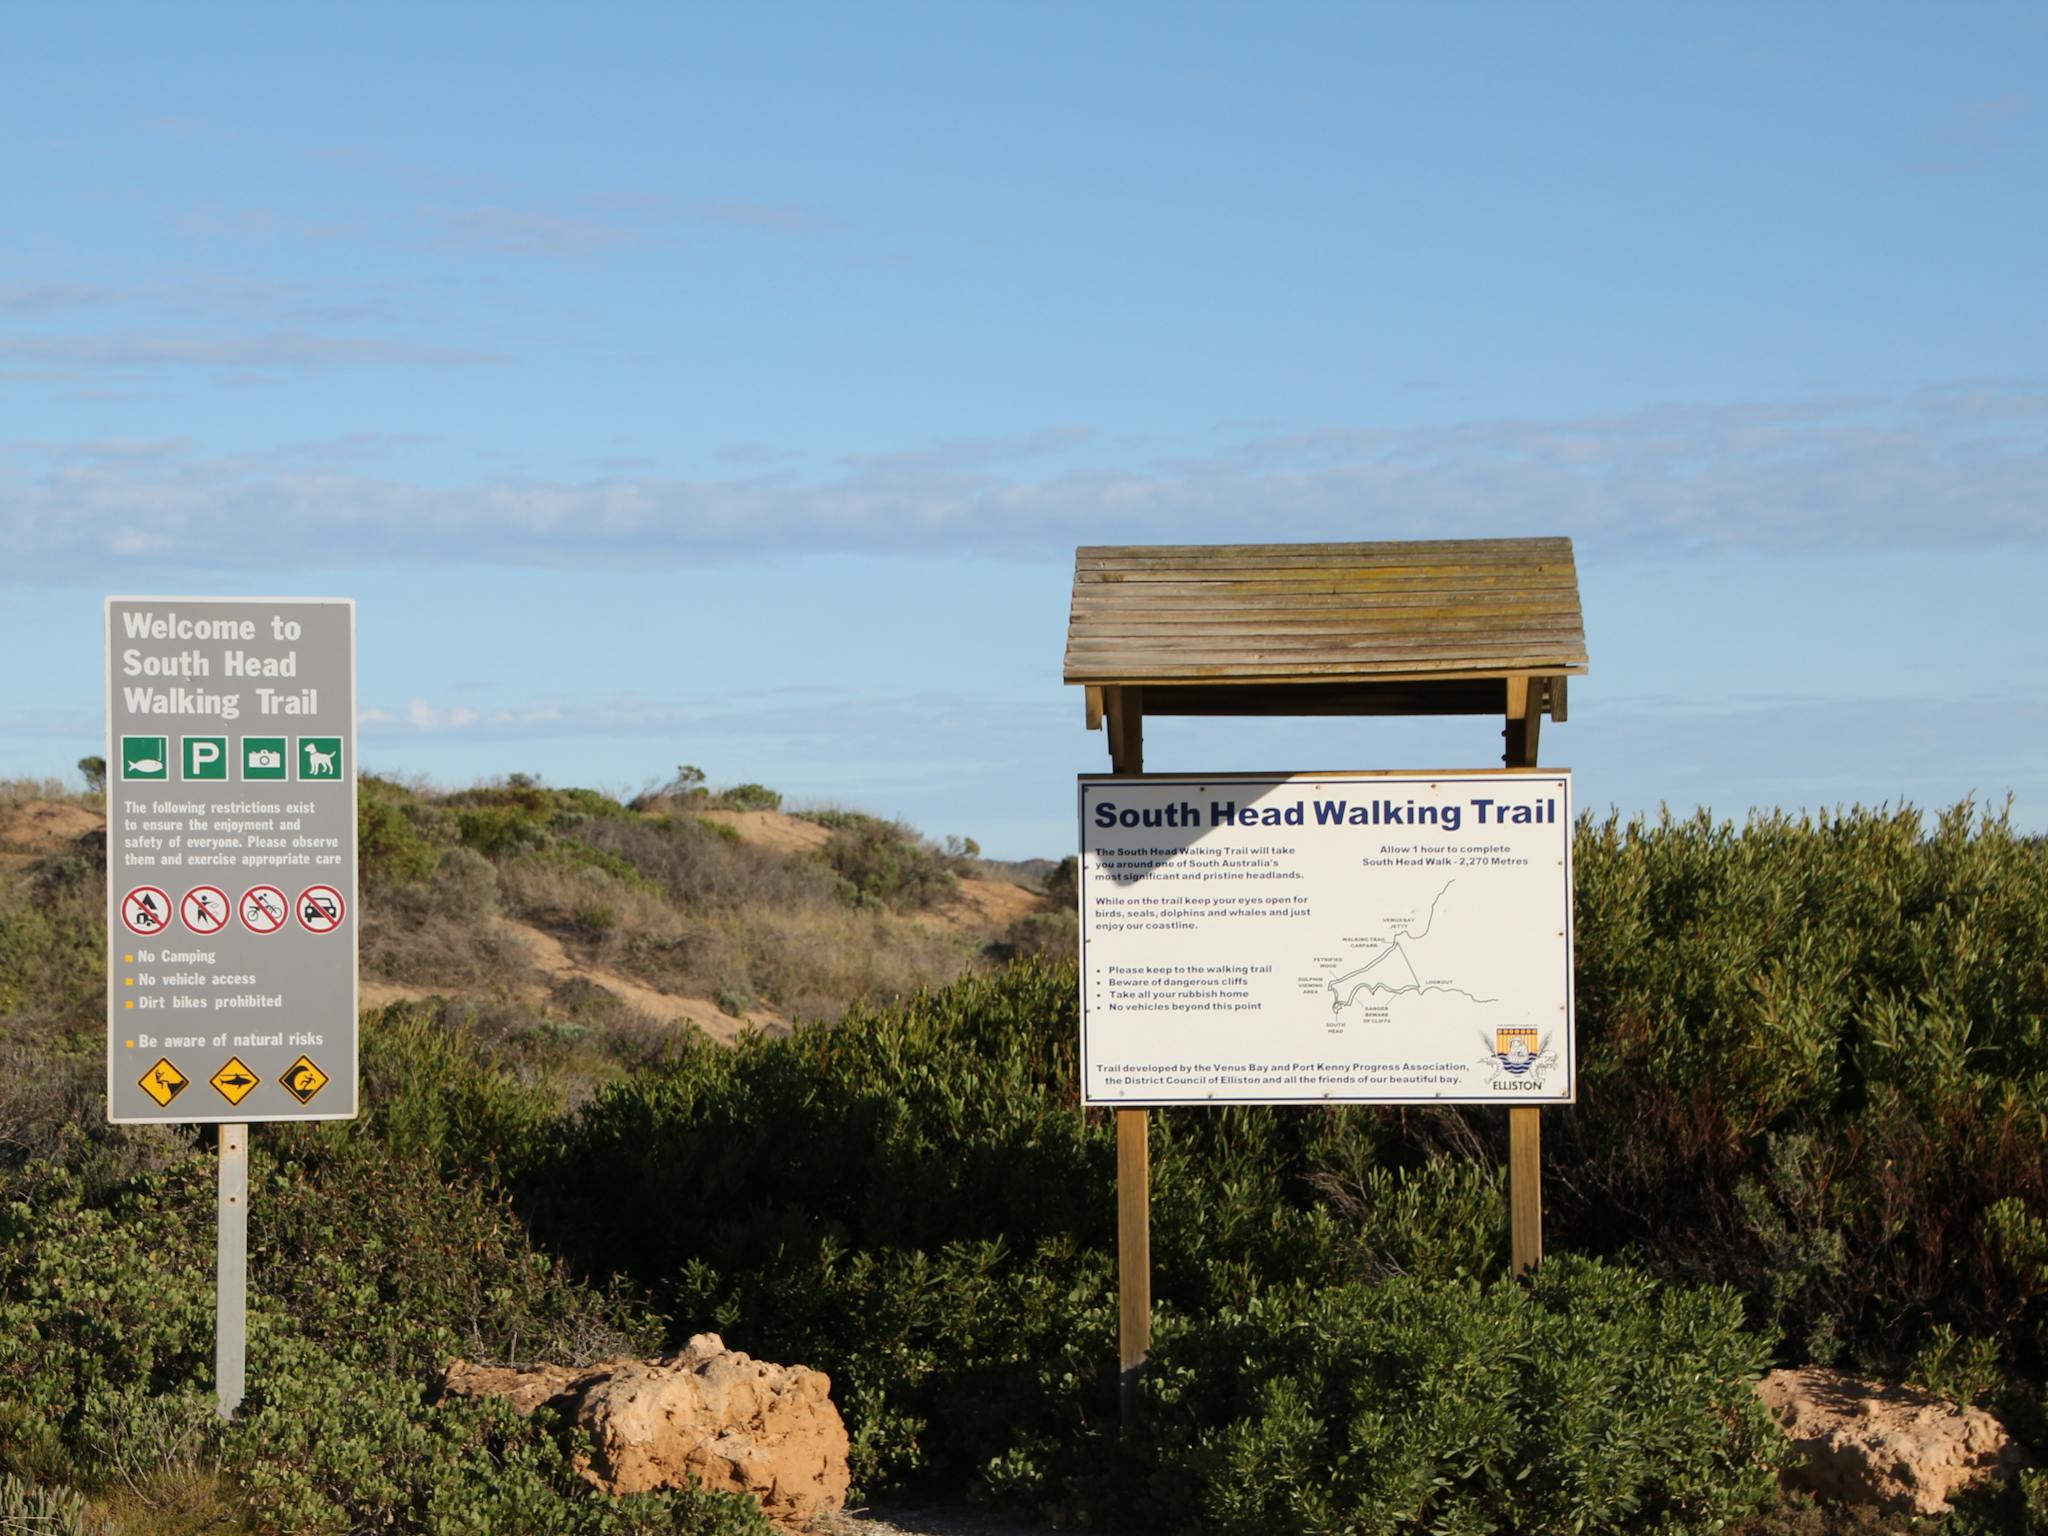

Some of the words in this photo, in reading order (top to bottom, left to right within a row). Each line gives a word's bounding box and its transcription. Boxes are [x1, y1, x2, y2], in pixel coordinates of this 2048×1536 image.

[122, 612, 256, 640] Welcome
[271, 615, 301, 640] to
[123, 649, 209, 676] South
[224, 651, 297, 677] Head
[123, 687, 240, 719] Walking
[255, 688, 318, 714] Trail
[193, 742, 219, 774] P
[124, 801, 147, 814] The
[152, 801, 206, 816] following
[211, 801, 280, 814] restrictions
[286, 801, 315, 814] exist
[1095, 802, 1200, 828] South
[1210, 801, 1305, 827] Head
[1313, 800, 1461, 831] Walking
[1470, 799, 1555, 824] Trail
[124, 819, 137, 831] to
[143, 821, 183, 831] ensure
[188, 819, 208, 831] the
[213, 819, 274, 833] enjoyment
[280, 818, 301, 831] and
[124, 835, 163, 850] safety
[168, 835, 181, 848] of
[187, 838, 243, 850] everyone.
[247, 835, 287, 848] Please
[292, 835, 338, 848] observe
[1095, 848, 1114, 856] The
[1117, 848, 1147, 856] South
[1150, 848, 1177, 856] Head
[1179, 848, 1221, 856] Walking
[1380, 846, 1410, 854] Allow
[1460, 845, 1511, 854] complete
[125, 852, 155, 865] them
[161, 852, 182, 865] and
[188, 852, 236, 865] exercise
[242, 852, 311, 867] appropriate
[316, 855, 342, 865] care
[1116, 860, 1153, 868] around
[1222, 859, 1279, 867] Australia's
[1362, 858, 1394, 866] South
[1396, 858, 1423, 866] Head
[1459, 857, 1489, 867] 2,270
[1491, 857, 1528, 865] Metres
[1123, 872, 1180, 881] significant
[1182, 872, 1201, 880] and
[1203, 872, 1244, 881] pristine
[1246, 871, 1305, 879] headlands.
[1142, 897, 1159, 905] the
[1161, 897, 1183, 905] trail
[1185, 897, 1211, 906] keep
[1213, 898, 1236, 906] your
[1096, 910, 1125, 918] birds,
[1127, 910, 1159, 918] seals,
[1160, 909, 1205, 918] dolphins
[1207, 909, 1227, 917] and
[1290, 908, 1311, 918] just
[1096, 923, 1124, 932] enjoy
[1146, 921, 1199, 930] coastline.
[138, 950, 155, 963] No
[161, 950, 216, 964] Camping
[1108, 966, 1144, 974] Please
[1146, 966, 1173, 975] keep
[1174, 966, 1185, 974] to
[1187, 966, 1204, 974] the
[1206, 965, 1248, 975] walking
[1250, 965, 1272, 973] trail
[139, 973, 156, 986] No
[163, 973, 205, 985] vehicle
[212, 975, 256, 985] access
[1108, 978, 1149, 986] Beware
[1151, 978, 1162, 986] of
[1164, 978, 1219, 988] dangerous
[1221, 977, 1248, 986] cliffs
[1110, 991, 1136, 999] Take
[1153, 992, 1176, 1000] your
[1178, 990, 1218, 998] rubbish
[1220, 990, 1249, 998] home
[139, 996, 165, 1009] Dirt
[173, 996, 207, 1008] bikes
[215, 994, 282, 1010] prohibited
[1109, 1003, 1123, 1011] No
[1125, 1002, 1170, 1011] vehicles
[1172, 1002, 1210, 1012] beyond
[1235, 1002, 1262, 1011] point
[139, 1034, 157, 1048] Be
[164, 1036, 205, 1047] aware
[213, 1033, 228, 1047] of
[234, 1033, 283, 1047] natural
[289, 1032, 323, 1046] risks
[1097, 1064, 1121, 1072] Trail
[1123, 1064, 1176, 1073] developed
[1180, 1064, 1192, 1074] by
[1194, 1064, 1211, 1072] the
[1213, 1064, 1247, 1072] Venus
[1249, 1064, 1269, 1073] Bay
[1270, 1063, 1291, 1071] and
[1292, 1063, 1314, 1071] Port
[1317, 1063, 1351, 1073] Kenny
[1353, 1063, 1401, 1073] Progress
[1402, 1063, 1470, 1072] Association,
[1105, 1077, 1122, 1085] the
[1124, 1076, 1164, 1085] District
[1166, 1076, 1206, 1084] Council
[1208, 1076, 1219, 1084] of
[1220, 1076, 1260, 1084] Elliston
[1262, 1076, 1282, 1084] and
[1284, 1076, 1297, 1084] all
[1299, 1076, 1316, 1084] the
[1318, 1075, 1355, 1084] friends
[1357, 1075, 1368, 1084] of
[1370, 1076, 1387, 1084] our
[1389, 1075, 1437, 1084] beautiful
[1439, 1075, 1462, 1085] bay.
[1493, 1081, 1541, 1091] ELLISTON
